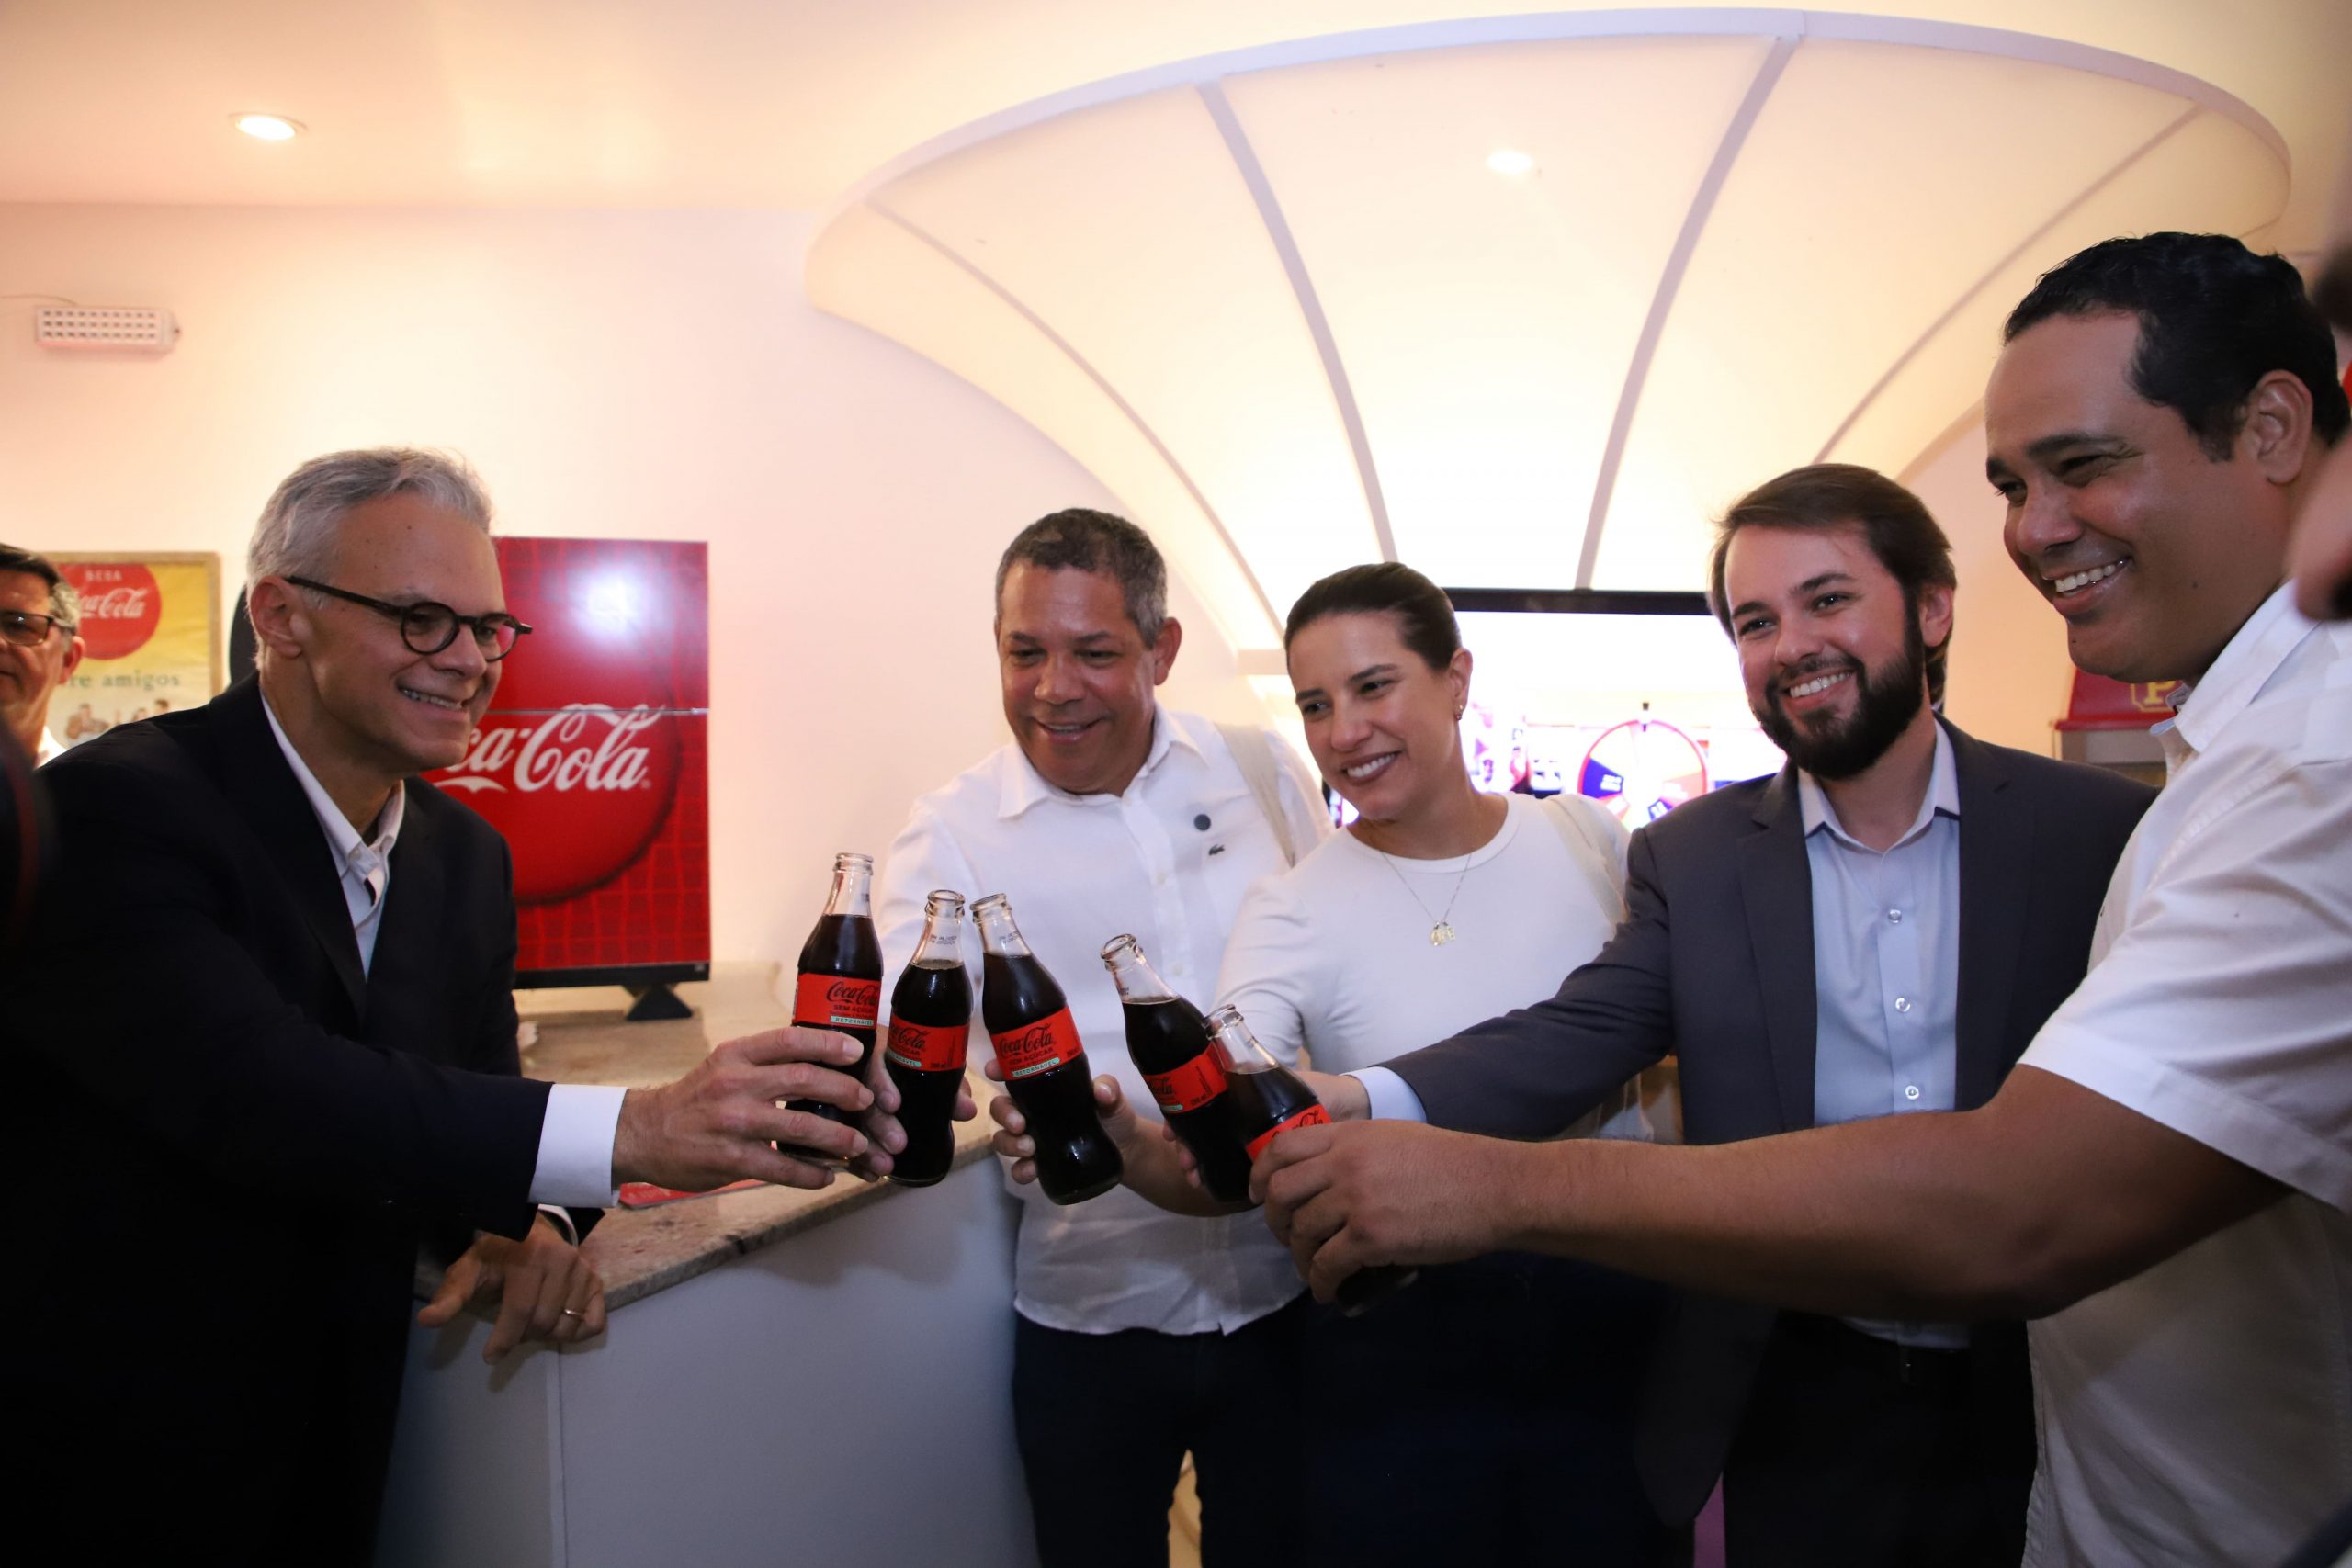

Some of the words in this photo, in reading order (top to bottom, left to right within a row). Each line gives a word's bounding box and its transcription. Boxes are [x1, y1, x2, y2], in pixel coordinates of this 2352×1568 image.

[85, 570, 122, 581] BEBA
[102, 670, 179, 691] amigos
[999, 1022, 1052, 1059] Coca-Cola
